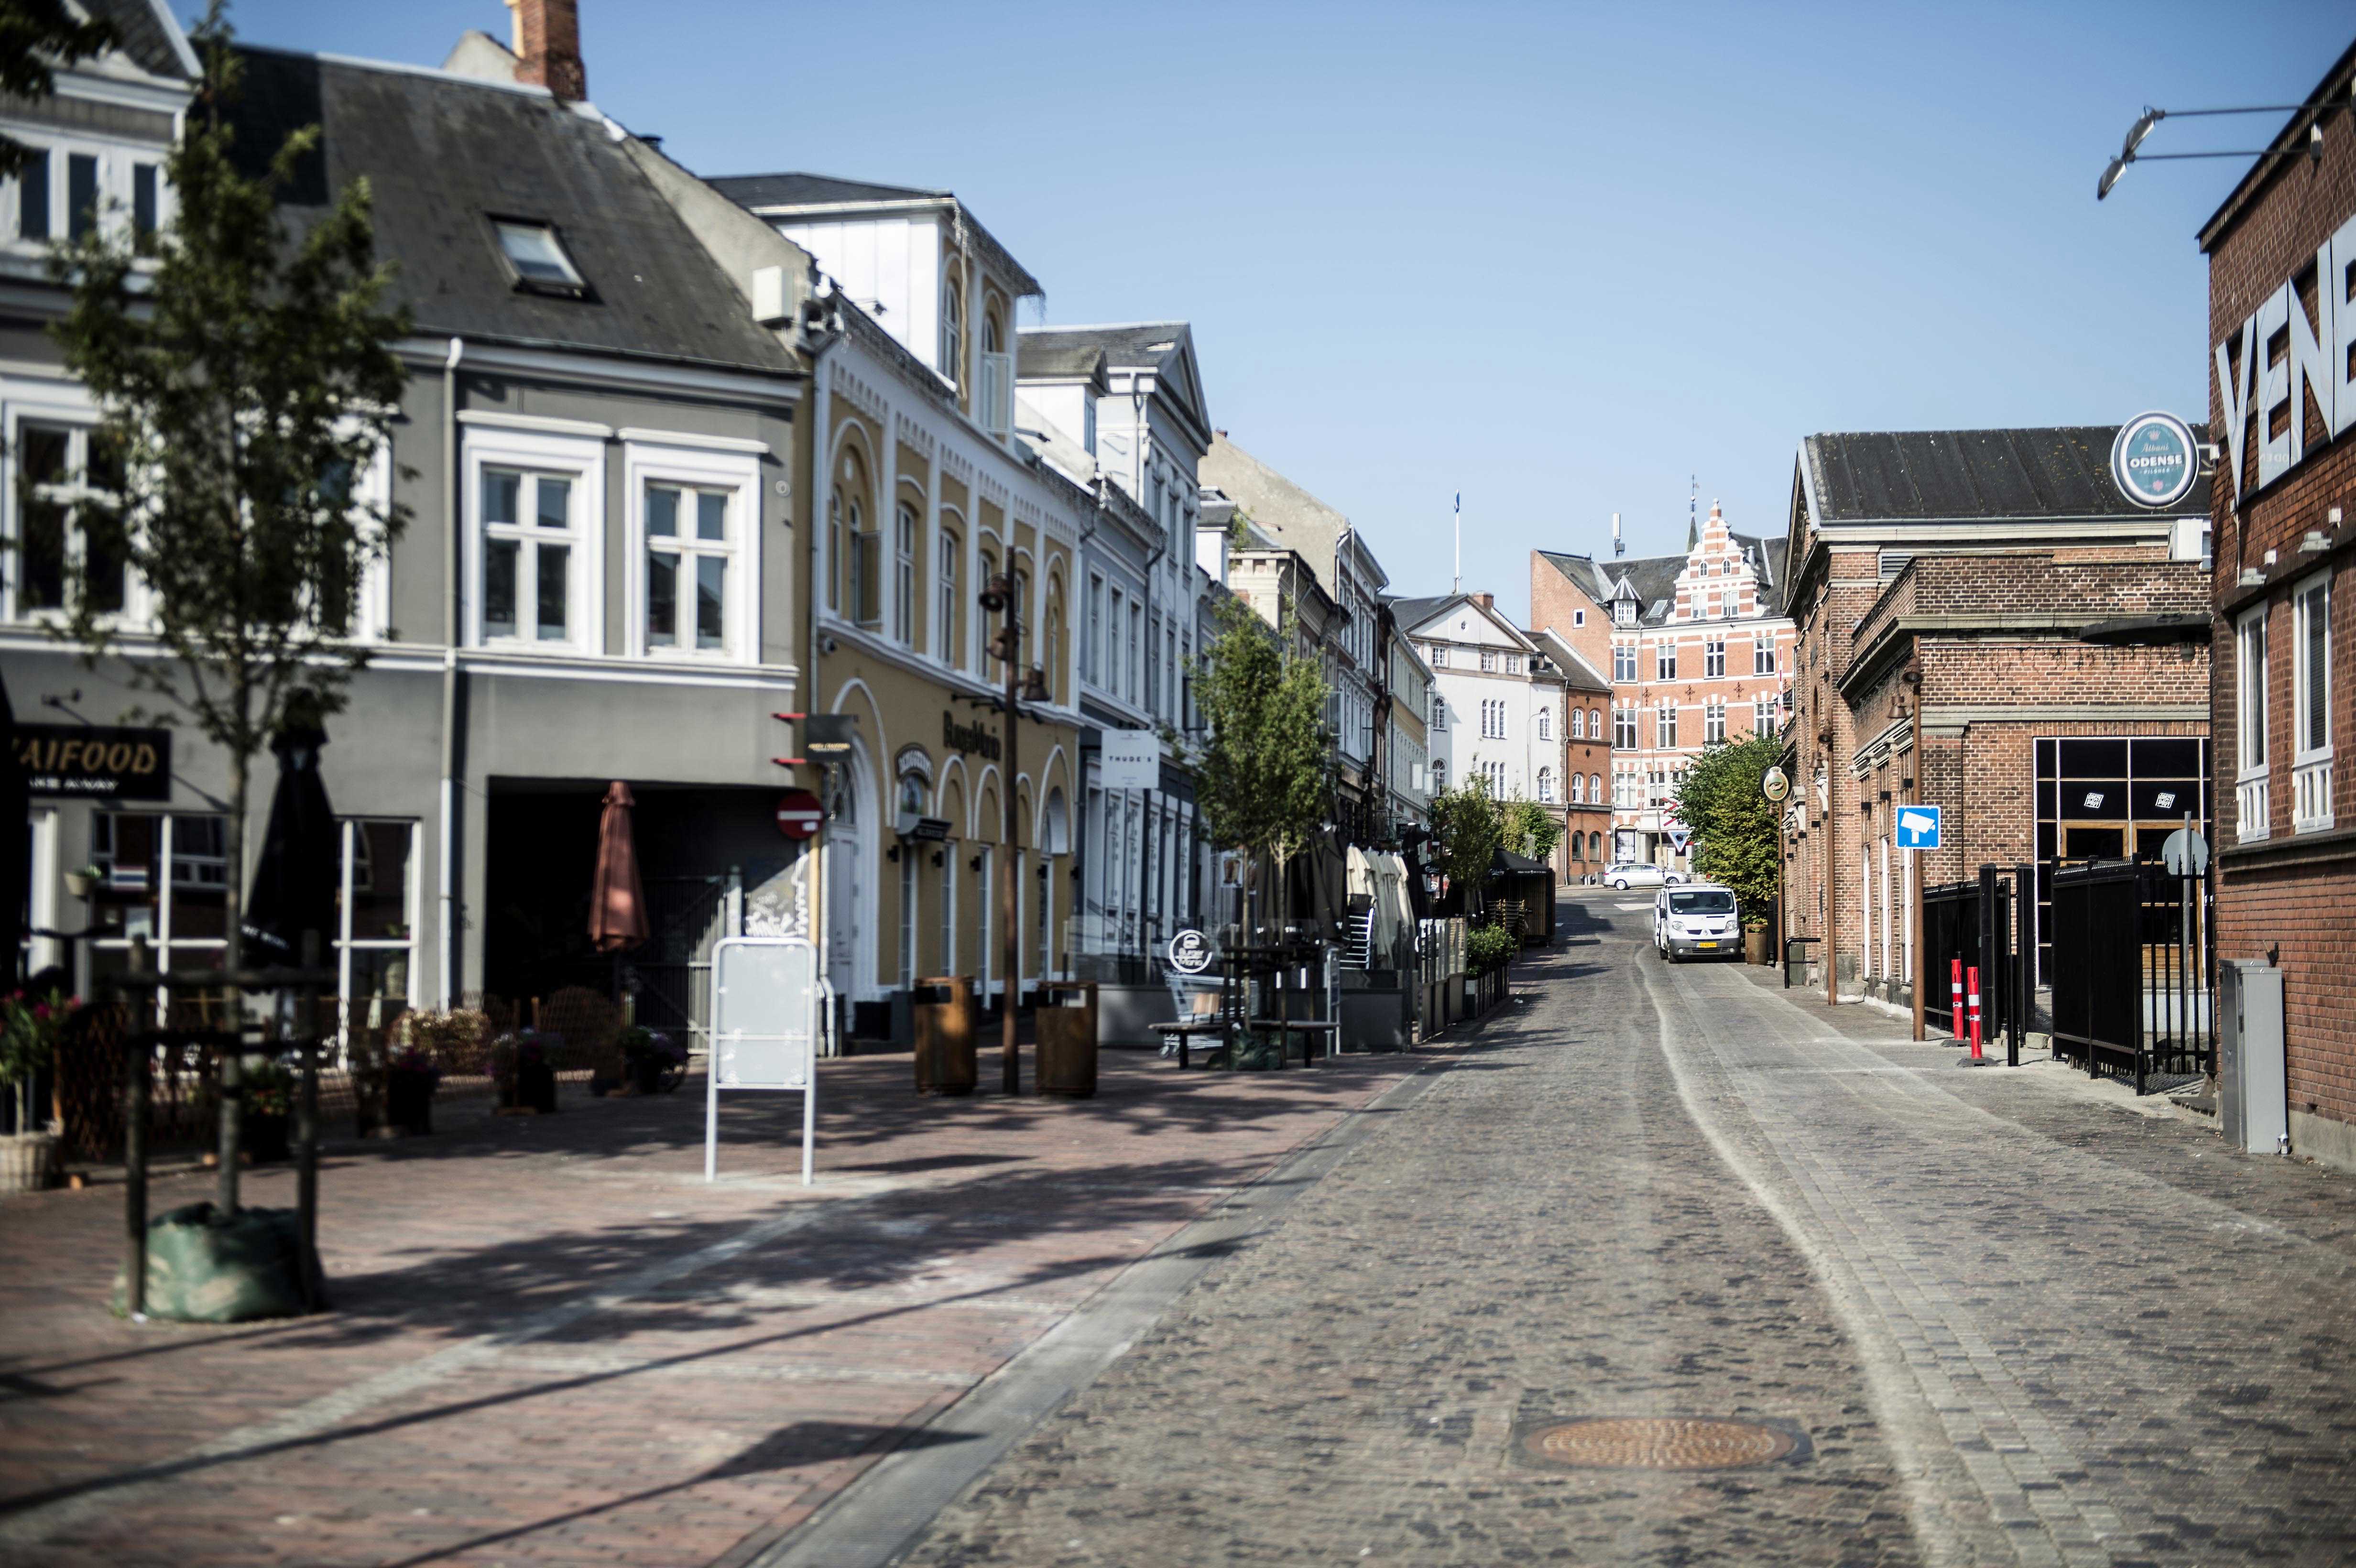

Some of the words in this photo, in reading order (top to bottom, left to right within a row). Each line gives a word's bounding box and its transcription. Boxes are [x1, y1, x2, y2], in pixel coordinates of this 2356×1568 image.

[2130, 454, 2182, 468] ODENSE
[11, 739, 158, 774] AIFOOD
[1178, 947, 1204, 959] Burger
